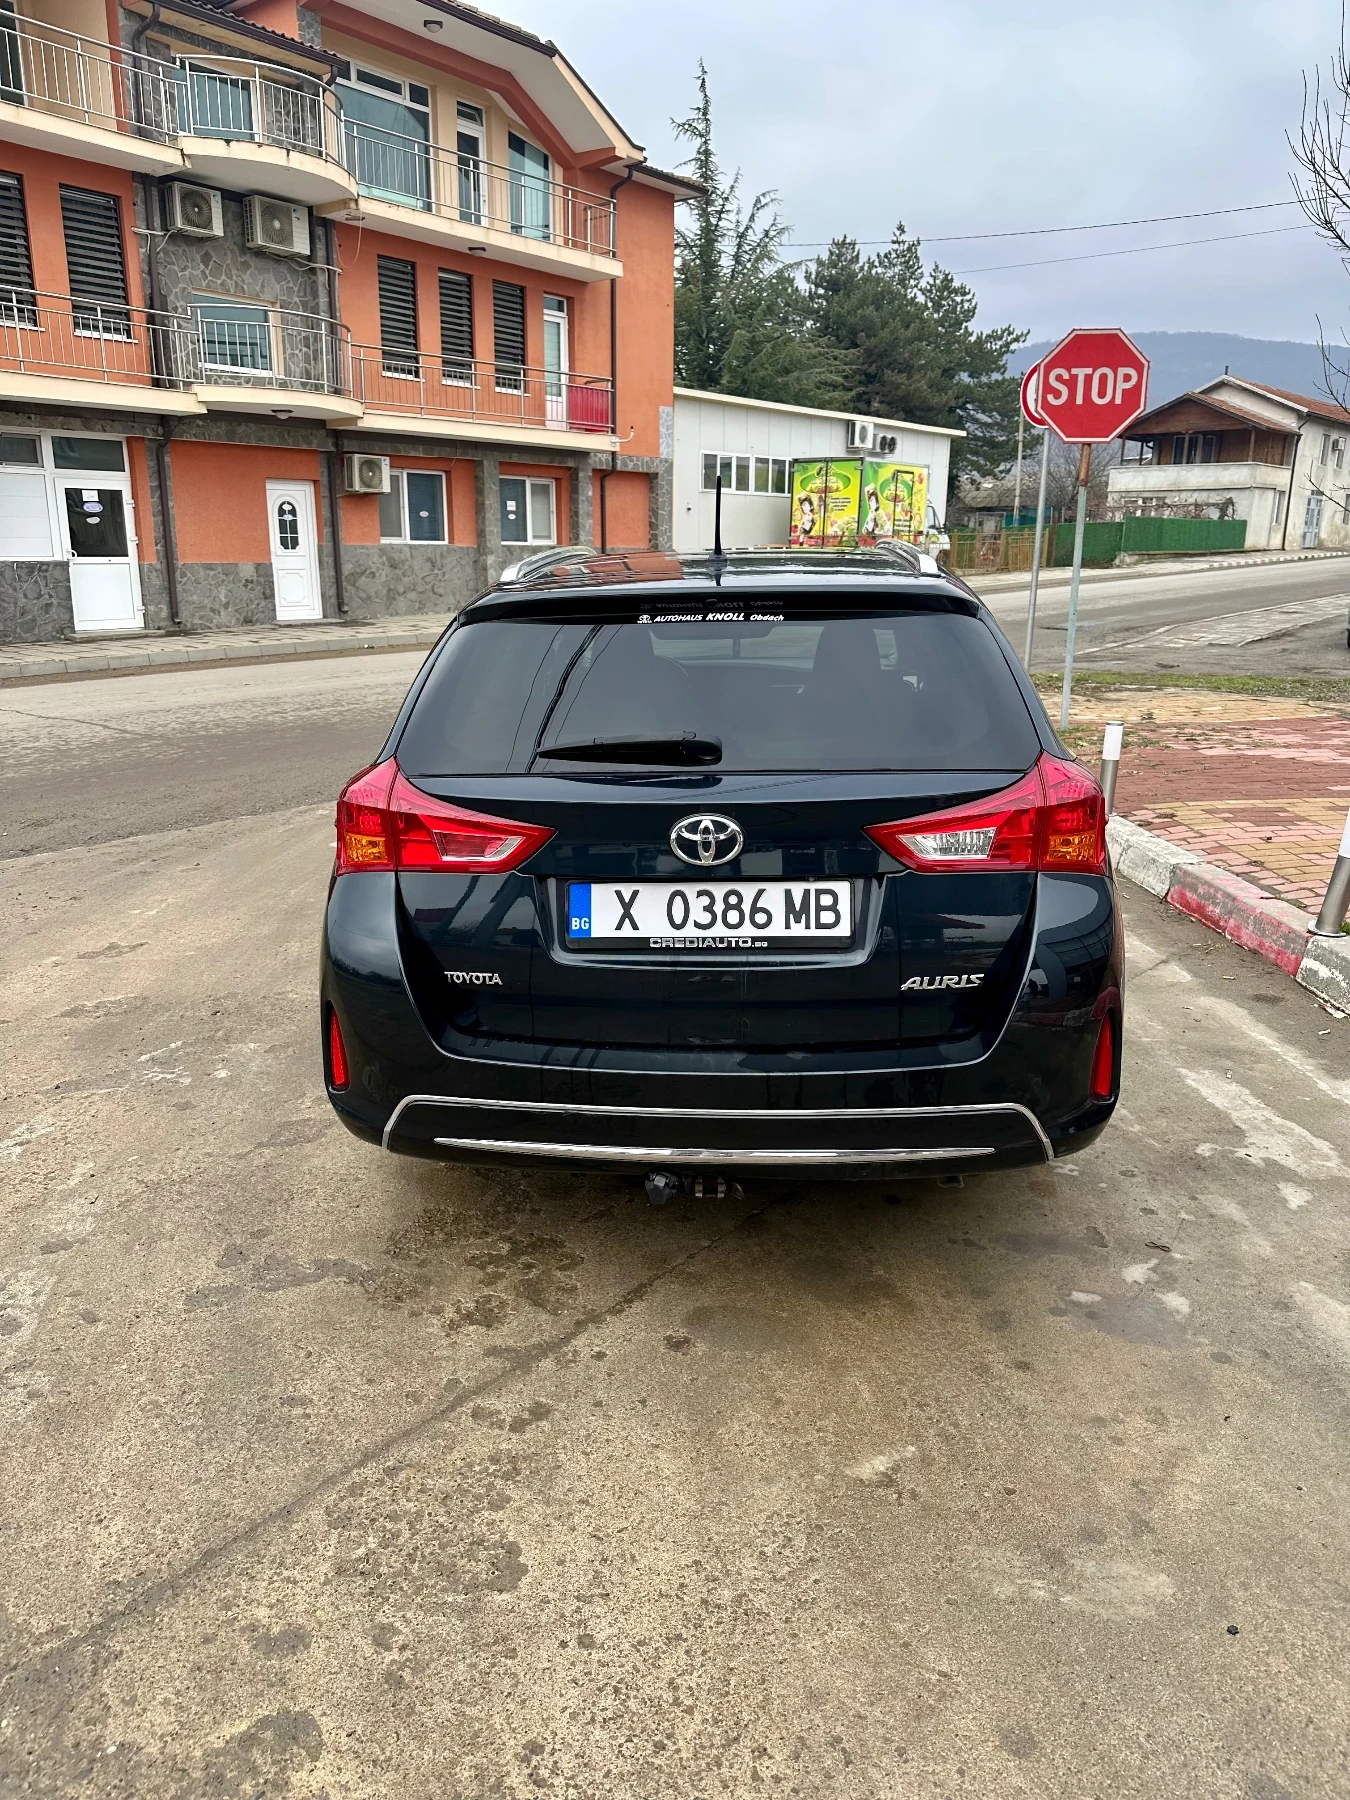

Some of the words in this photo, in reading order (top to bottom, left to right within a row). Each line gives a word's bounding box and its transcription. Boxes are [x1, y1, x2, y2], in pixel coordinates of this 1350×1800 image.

[1047, 367, 1138, 405] STOP
[653, 614, 704, 622] AUTOHAUS
[706, 612, 745, 621] KNOLL
[749, 613, 784, 622] Obdach
[614, 889, 640, 931] X
[666, 889, 773, 930] 0386
[784, 888, 842, 930] MB
[571, 917, 590, 930] BG
[443, 971, 503, 986] TOYOTA
[900, 973, 985, 991] AURIS
